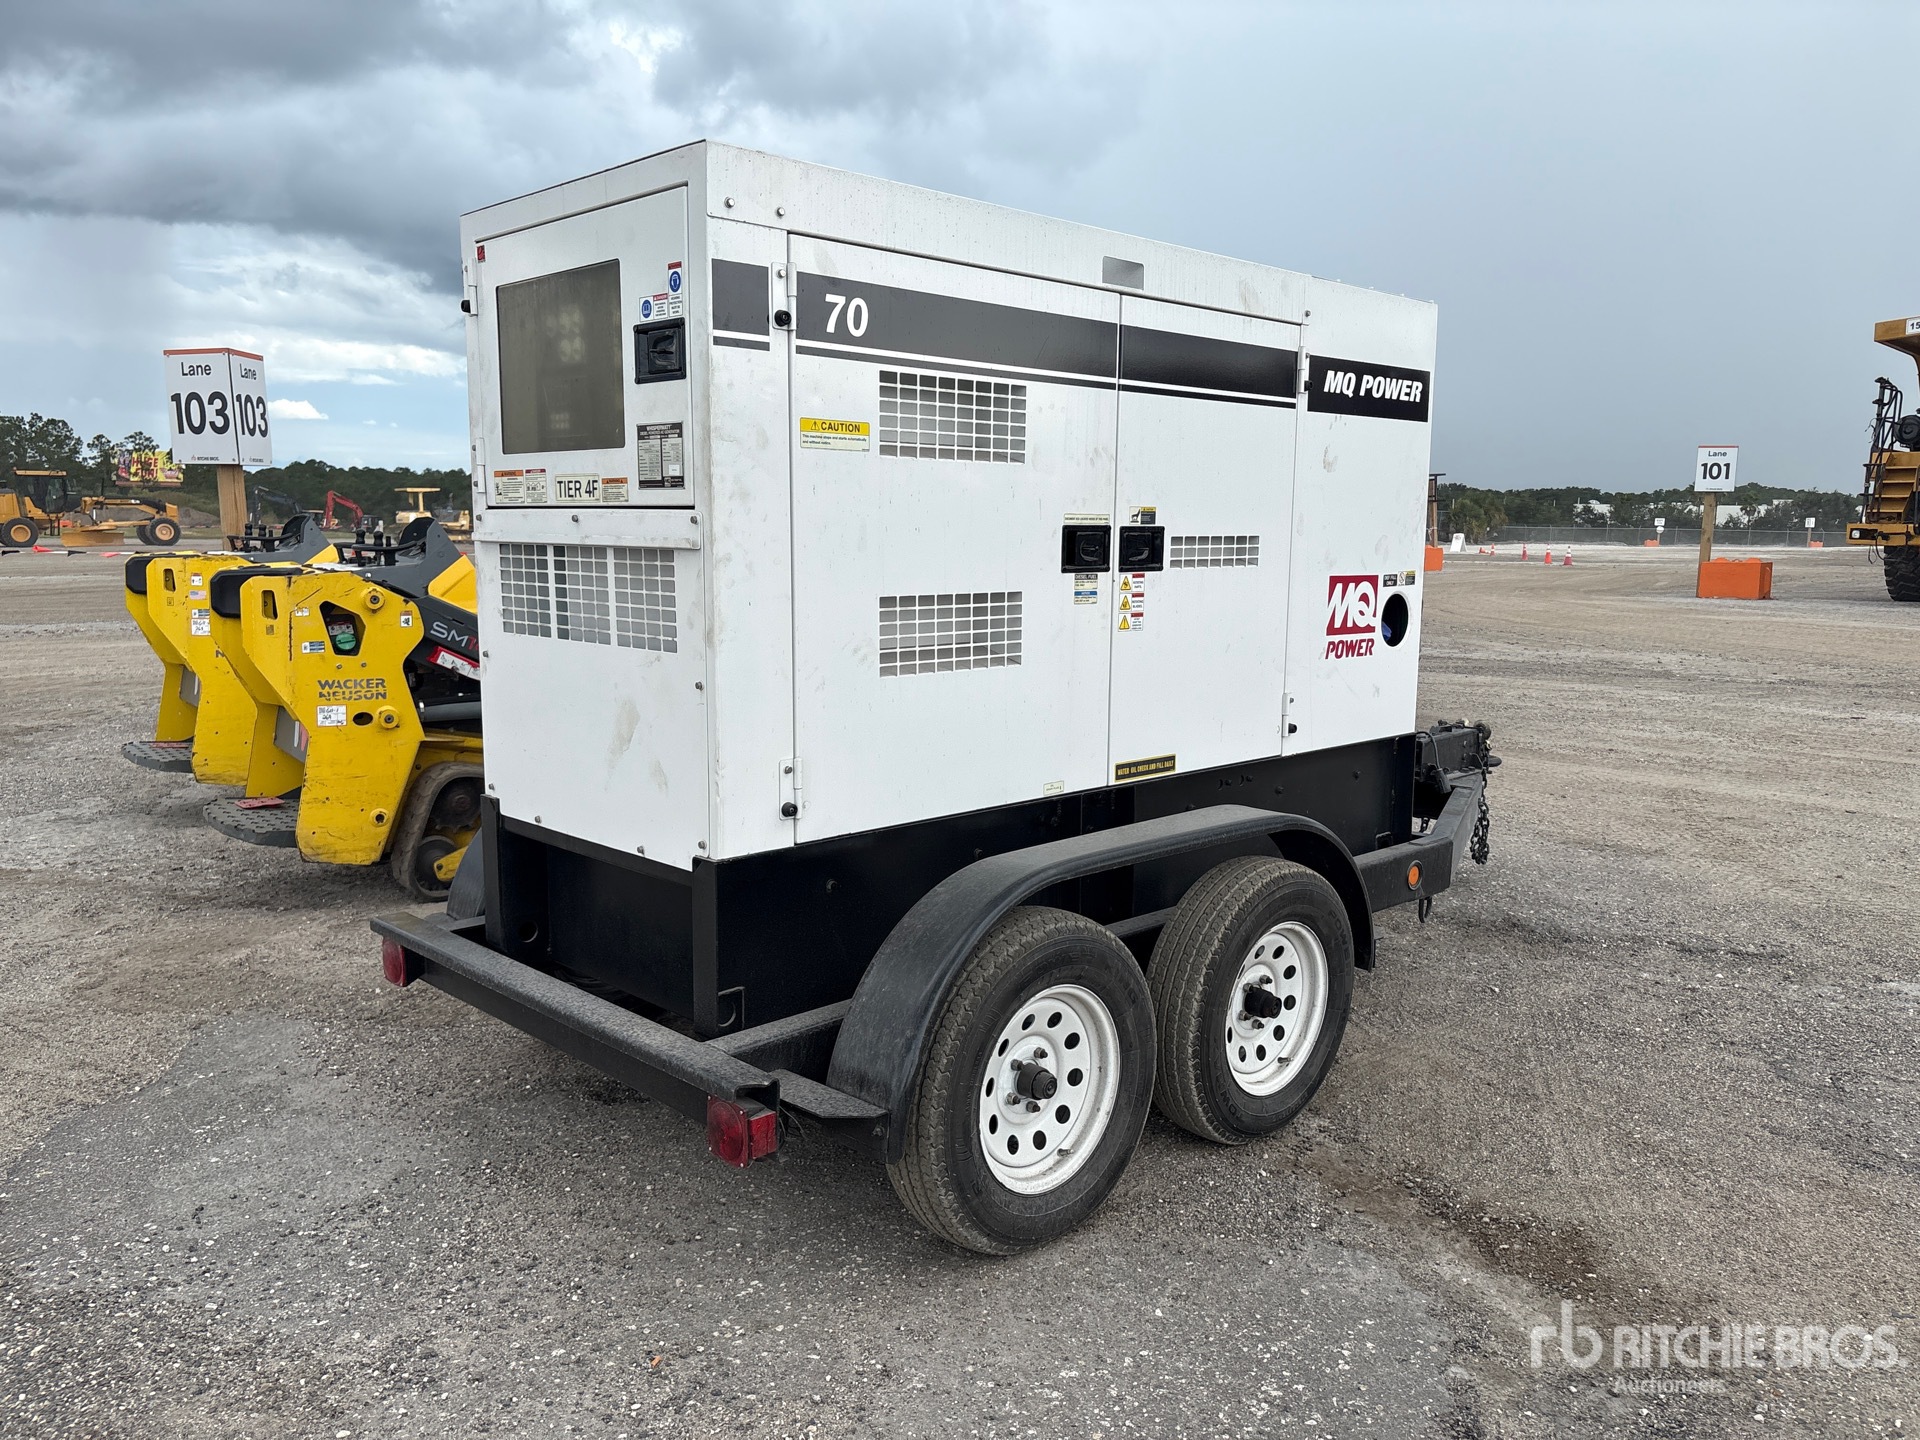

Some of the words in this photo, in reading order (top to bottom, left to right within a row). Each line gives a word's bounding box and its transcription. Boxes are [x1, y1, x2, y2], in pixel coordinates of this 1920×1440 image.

[825, 293, 869, 337] 70
[181, 362, 211, 376] Lane
[240, 363, 257, 380] Lane
[1324, 370, 1356, 398] MQ
[1359, 374, 1423, 402] POWER
[170, 391, 230, 435] 103
[236, 394, 268, 438] 103
[821, 422, 860, 433] CAUTION
[1701, 462, 1730, 480] 101
[557, 480, 582, 498] TIER
[585, 479, 598, 498] 4F
[1327, 581, 1376, 628] MQ
[1325, 638, 1375, 660] POWER
[317, 678, 387, 690] WACKER
